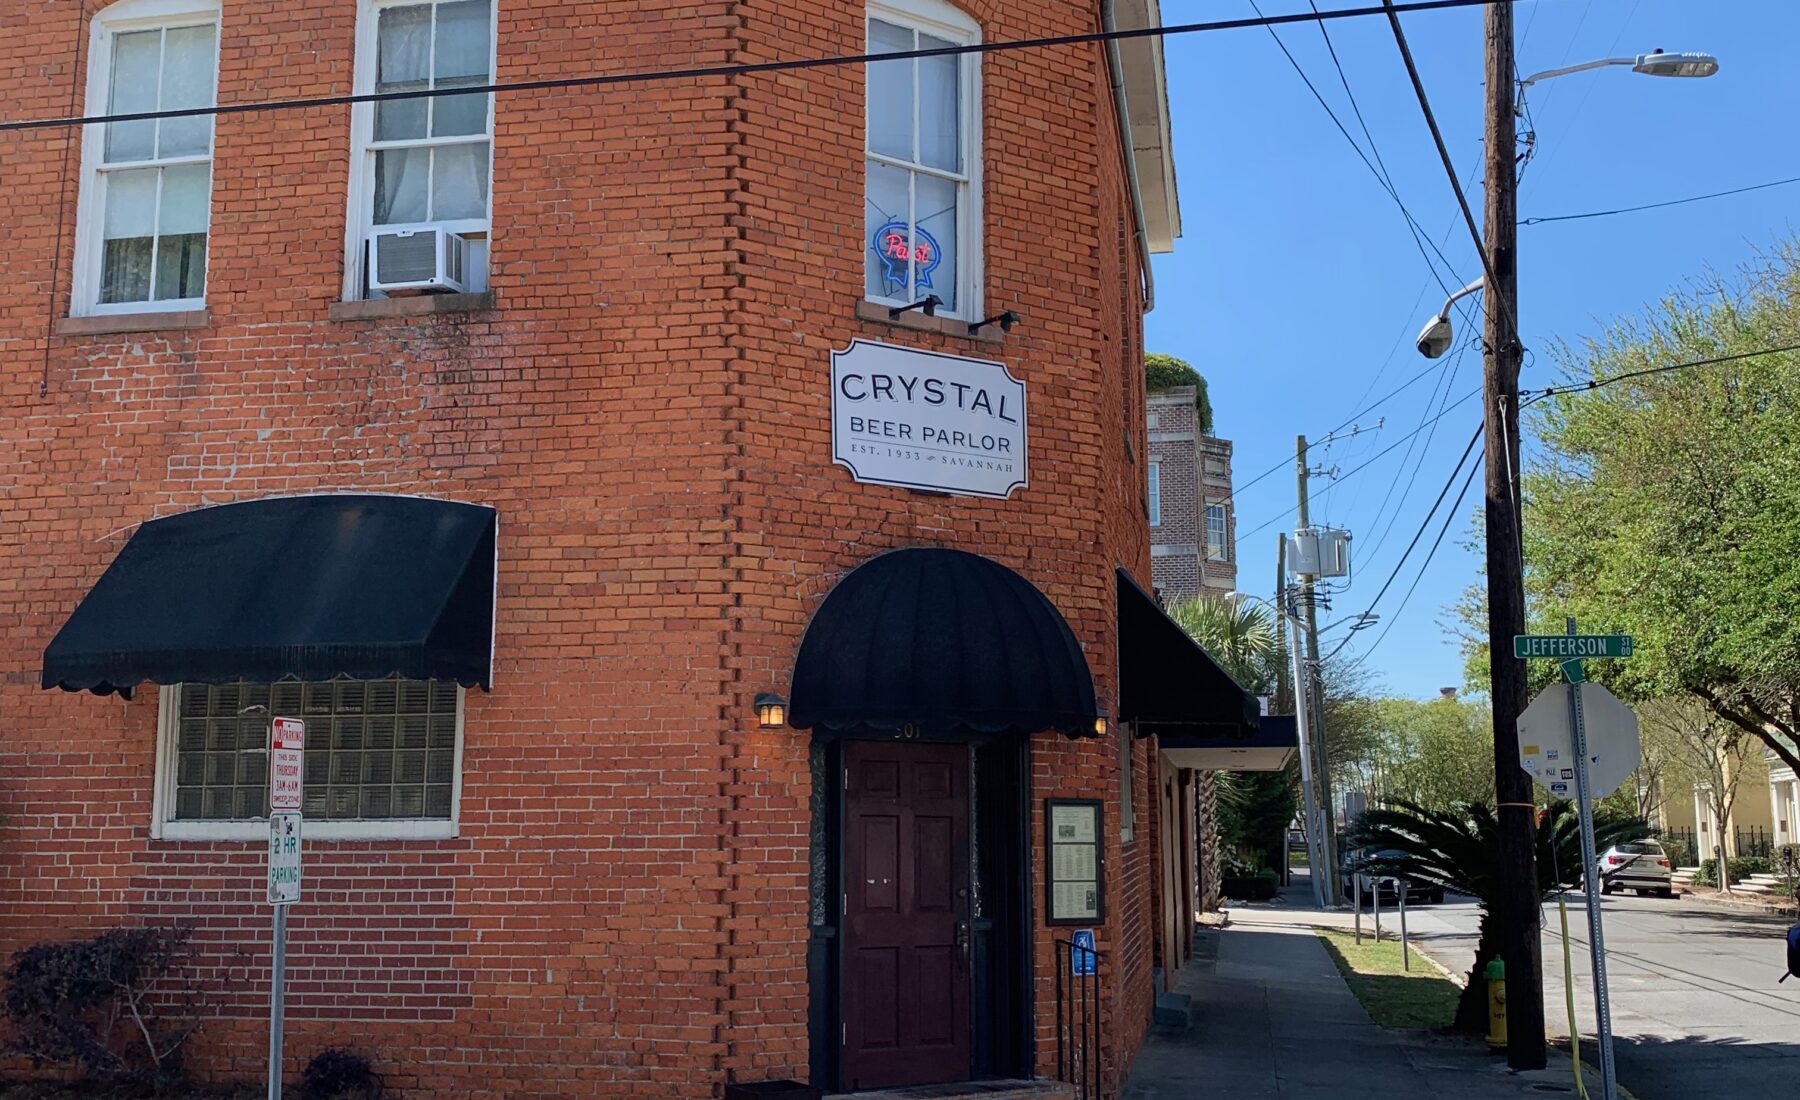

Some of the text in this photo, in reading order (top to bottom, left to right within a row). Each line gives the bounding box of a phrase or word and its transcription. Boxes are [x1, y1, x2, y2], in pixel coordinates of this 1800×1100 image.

[886, 234, 930, 263] Past
[841, 374, 1017, 424] CRYSTAL
[850, 417, 1011, 452] BEER PARLOR
[851, 444, 1013, 472] EST. 1933 SAVANNAH
[1522, 637, 1631, 655] JEFFERSON ST
[274, 725, 302, 742] NO PARKING
[276, 764, 298, 776] THURSDAY
[274, 837, 296, 854] 2 HR
[272, 867, 297, 883] PARKING
